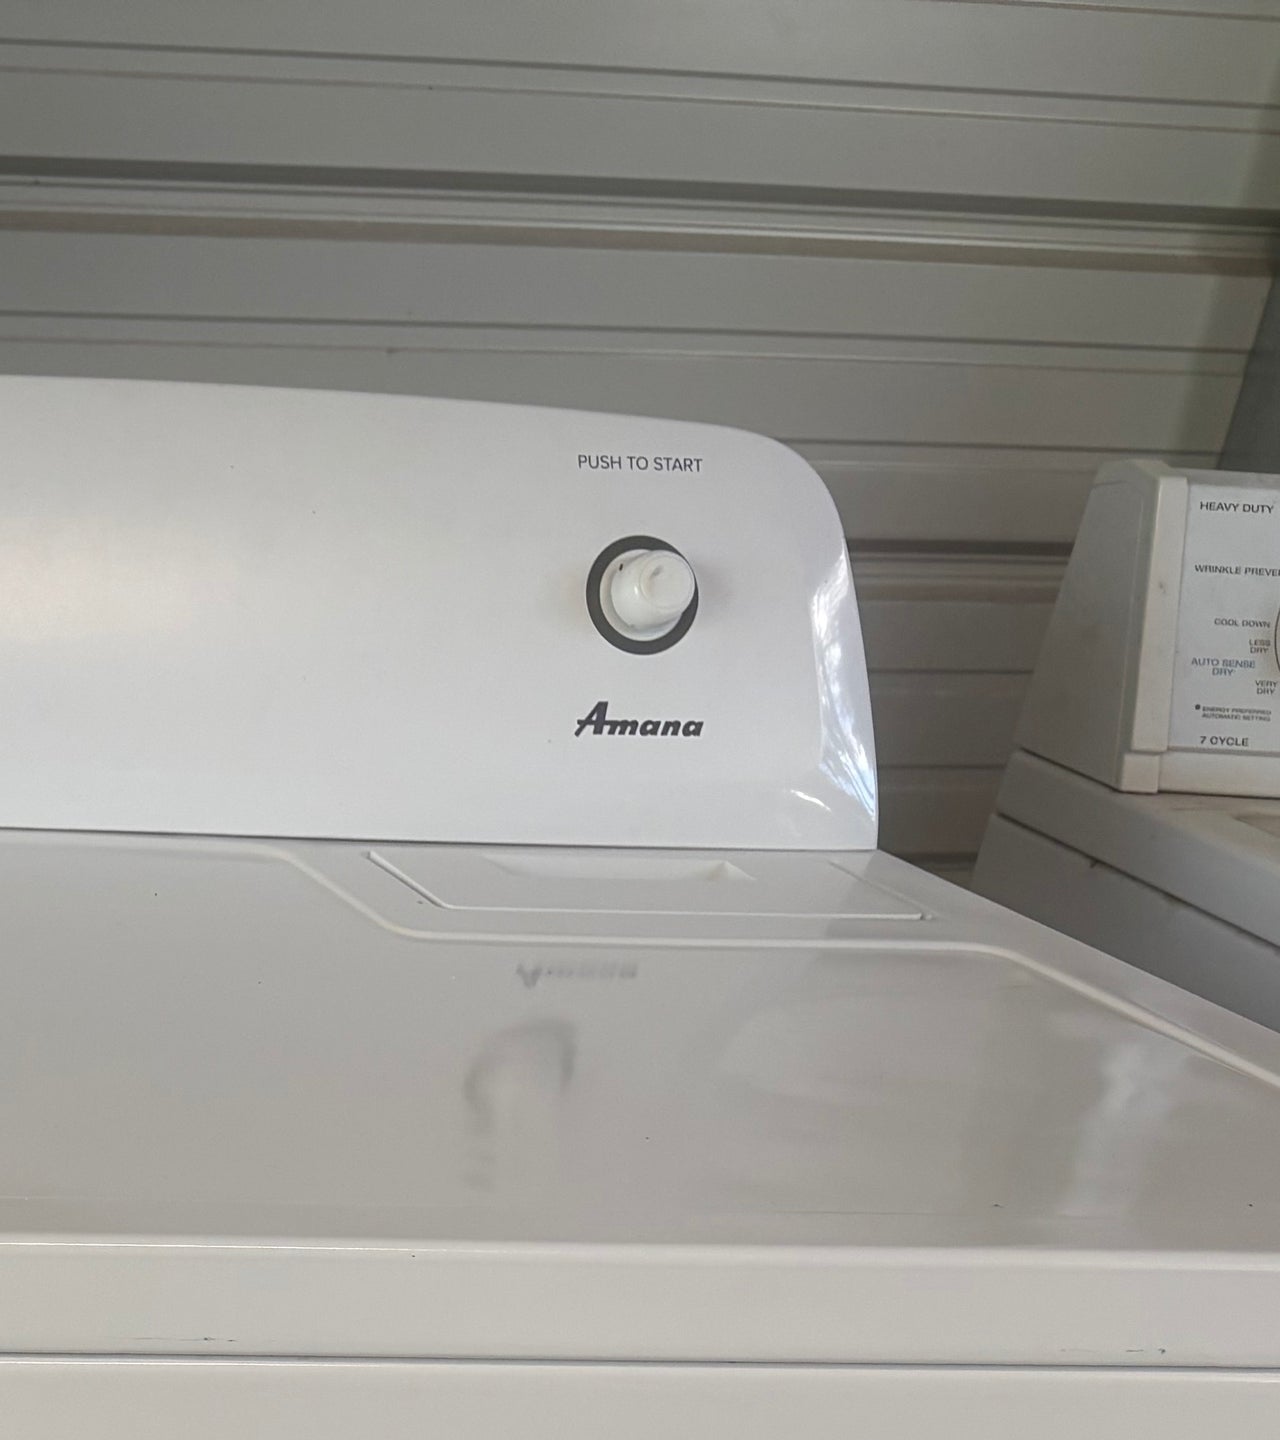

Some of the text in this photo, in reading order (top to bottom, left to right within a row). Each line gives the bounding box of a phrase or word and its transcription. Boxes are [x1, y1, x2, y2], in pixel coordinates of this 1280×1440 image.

[577, 454, 703, 473] PUSH TO START
[1199, 501, 1275, 514] HEAVY DUTY
[1194, 564, 1280, 577] WRINKLE PREVE
[1214, 618, 1271, 629] COOL DOWN
[1249, 639, 1271, 647] LESS
[1250, 646, 1269, 654] DRY
[1191, 657, 1220, 666] AUTO
[574, 701, 704, 738] Amana
[1200, 736, 1249, 747] 7 CYCLE
